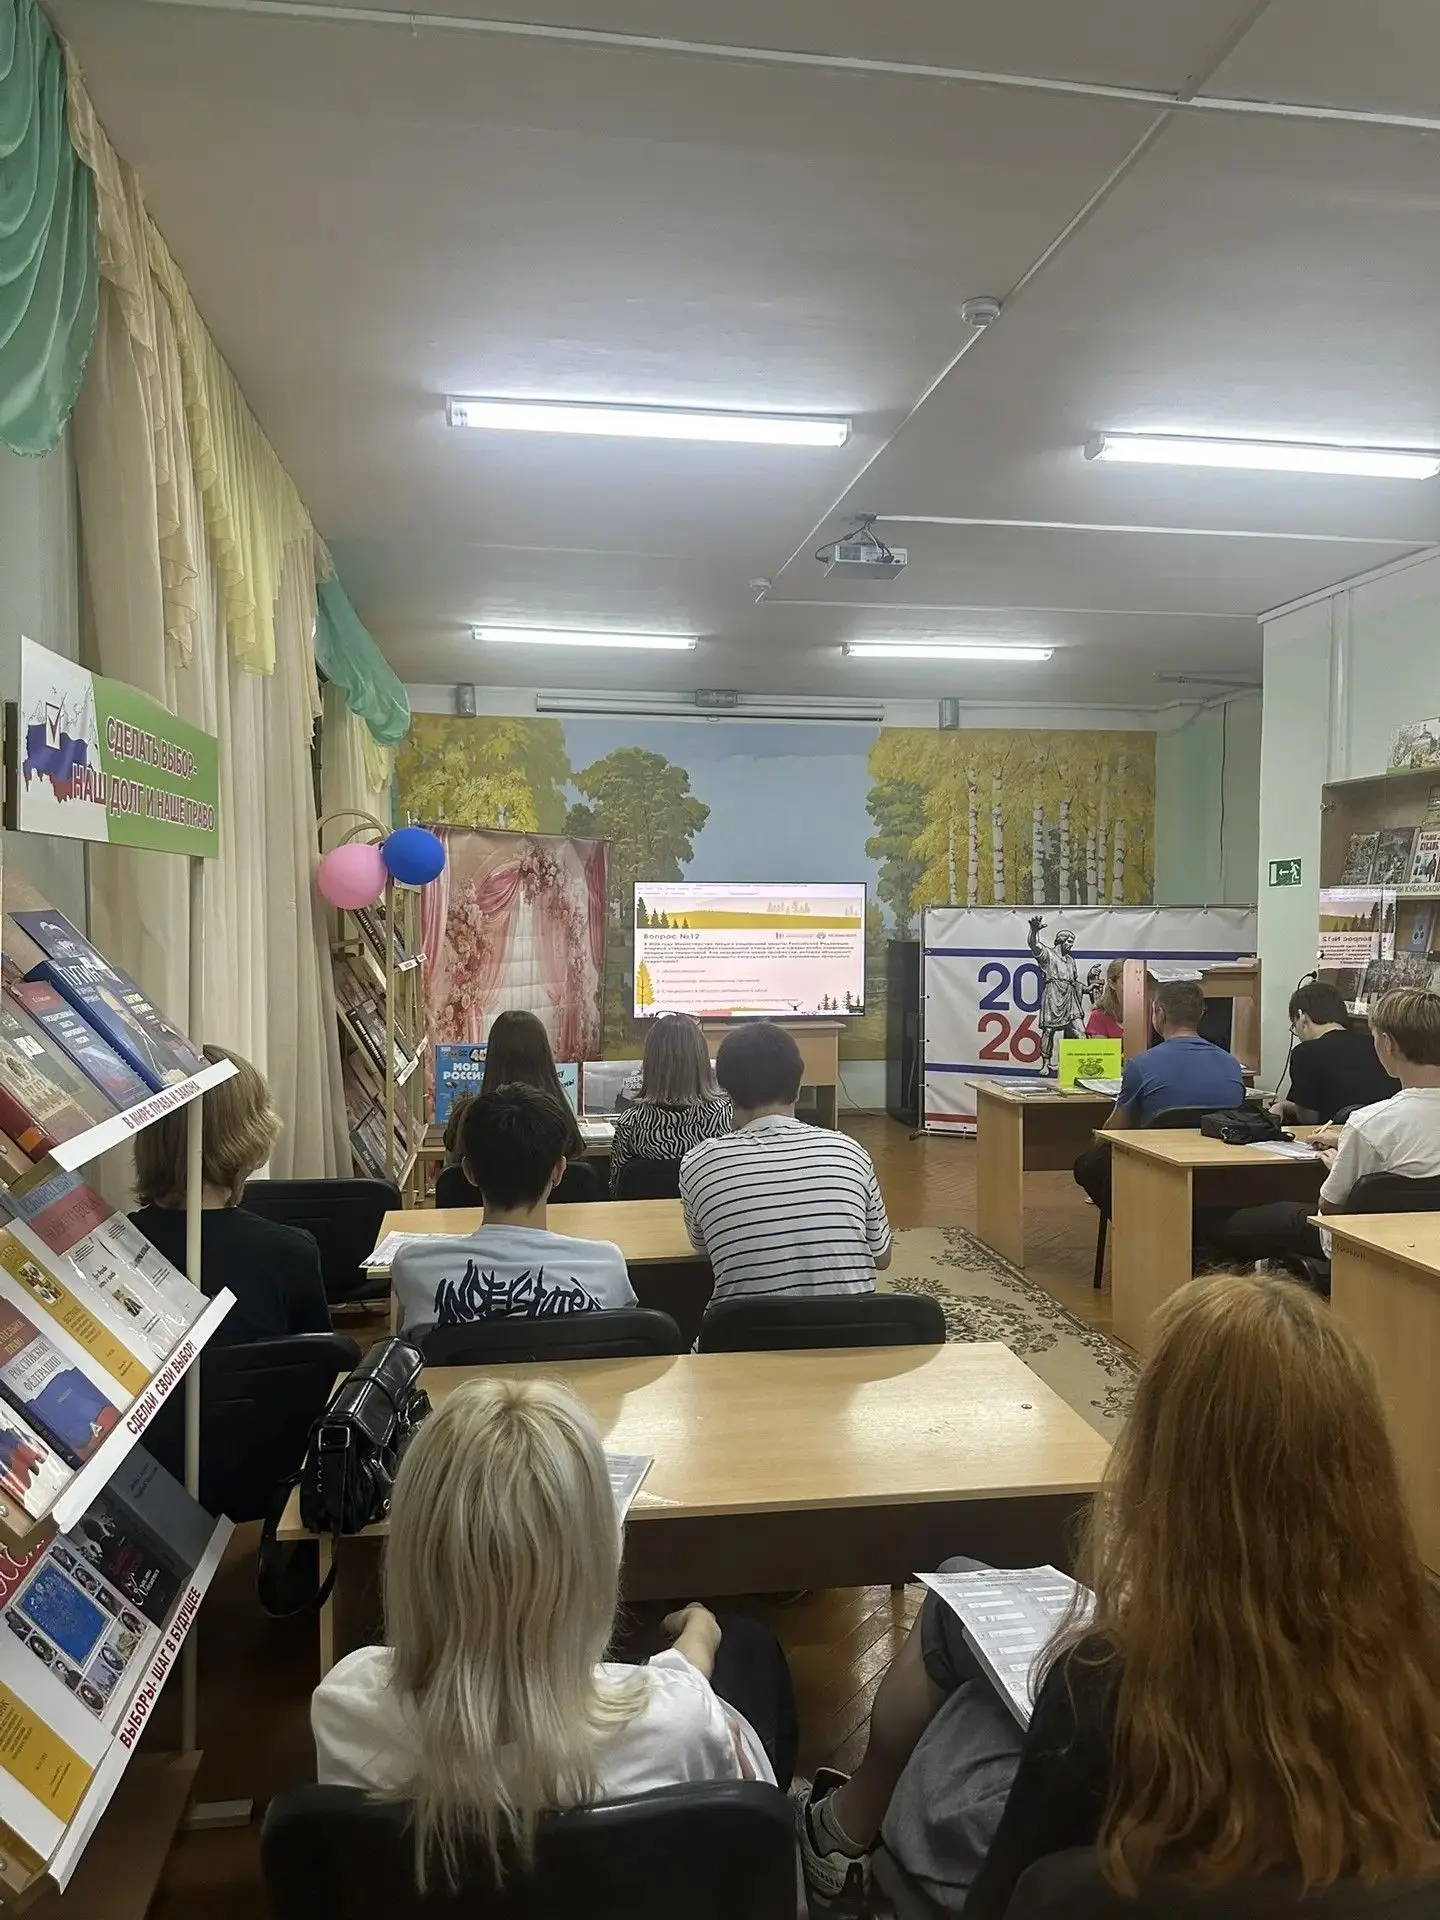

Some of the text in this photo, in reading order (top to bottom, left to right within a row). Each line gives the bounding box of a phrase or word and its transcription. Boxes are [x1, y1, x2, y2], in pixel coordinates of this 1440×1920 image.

[106, 715, 159, 767] СДЕЛАТЬ
[72, 762, 216, 832] НАШ ДОЛГ И НАШЕ ПРАВО
[977, 962, 1043, 1013] 20
[977, 1012, 1042, 1063] 26
[453, 1062, 479, 1072] МОЯ
[122, 1080, 202, 1129] В МИРЕ ПРАВА И ЗАКОНА
[126, 1392, 158, 1435] СДЕЛАЙ
[155, 1361, 178, 1397] СВОЙ
[174, 1342, 198, 1379] ВЫБОР!
[170, 1586, 202, 1648] БУДУЩЕЕ
[151, 1649, 172, 1681] ШАГ
[165, 1634, 178, 1652] В
